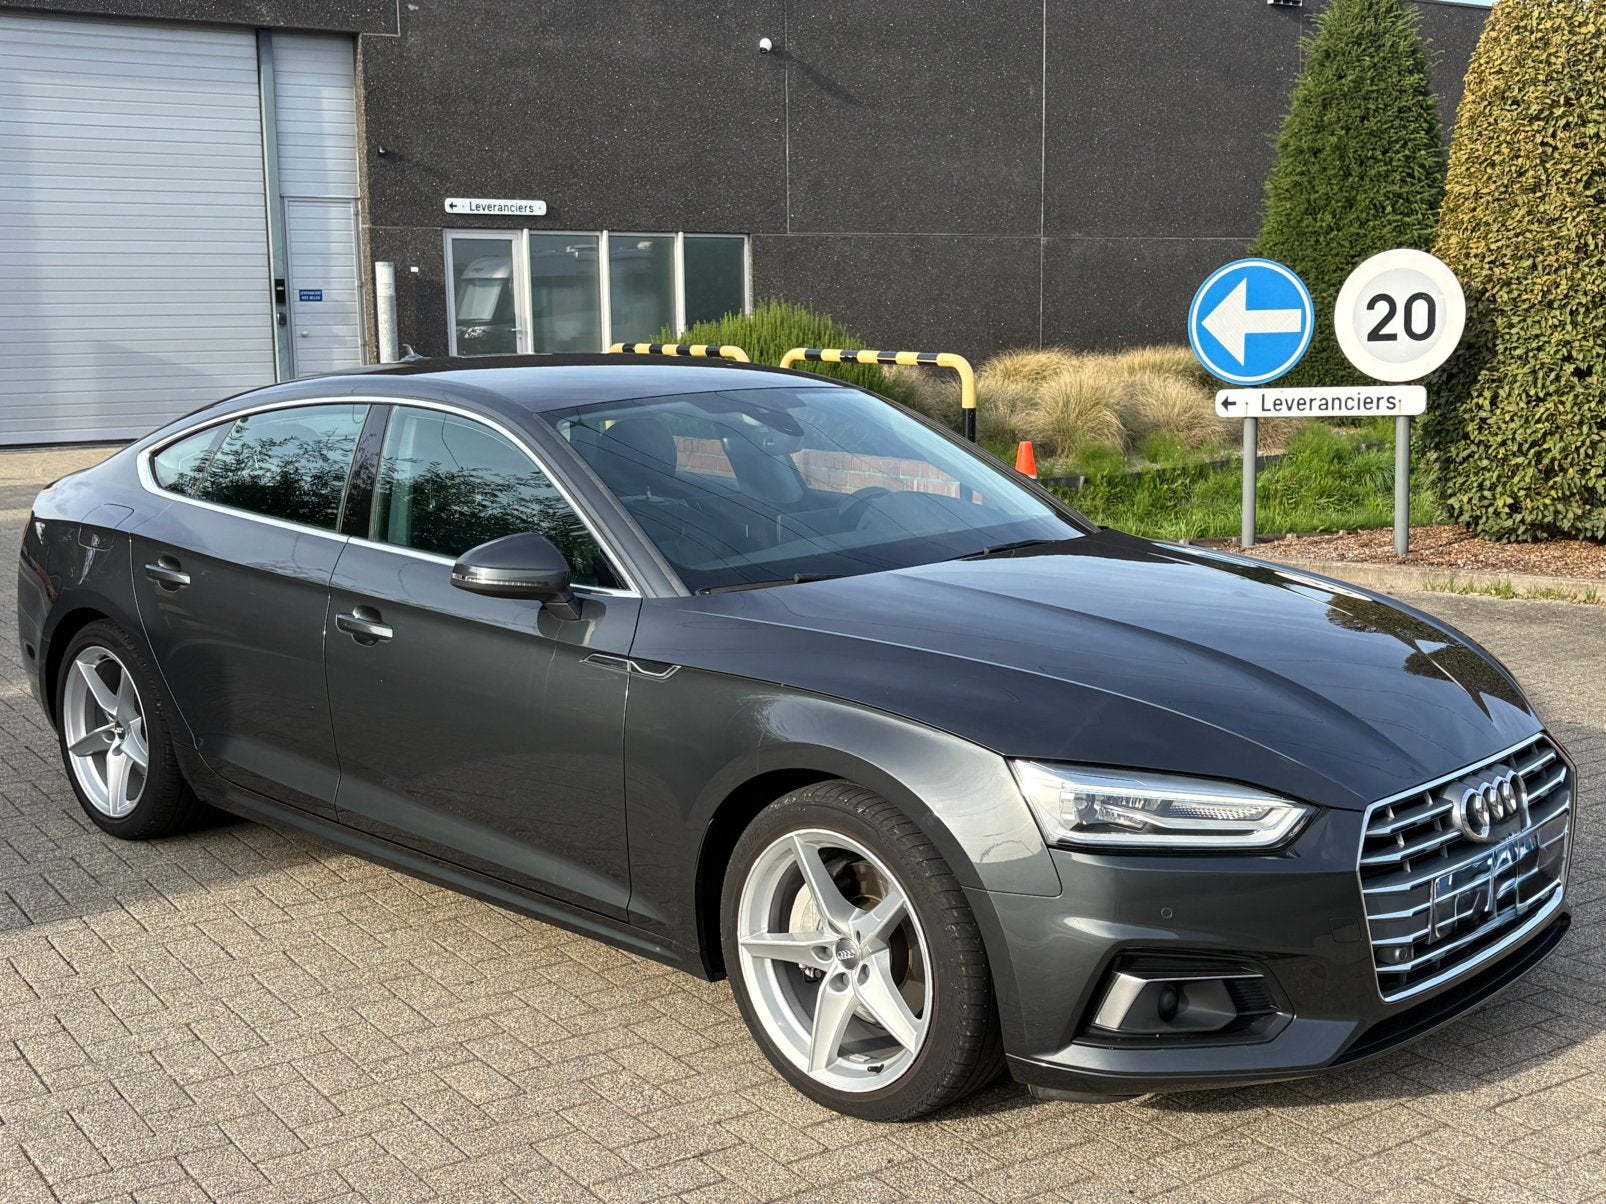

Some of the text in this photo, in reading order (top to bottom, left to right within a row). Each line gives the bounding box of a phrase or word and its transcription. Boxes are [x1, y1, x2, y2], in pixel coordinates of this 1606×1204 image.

[469, 201, 534, 213] Leveranciers
[1366, 292, 1436, 342] 20
[1261, 392, 1397, 412] Leveranciers
